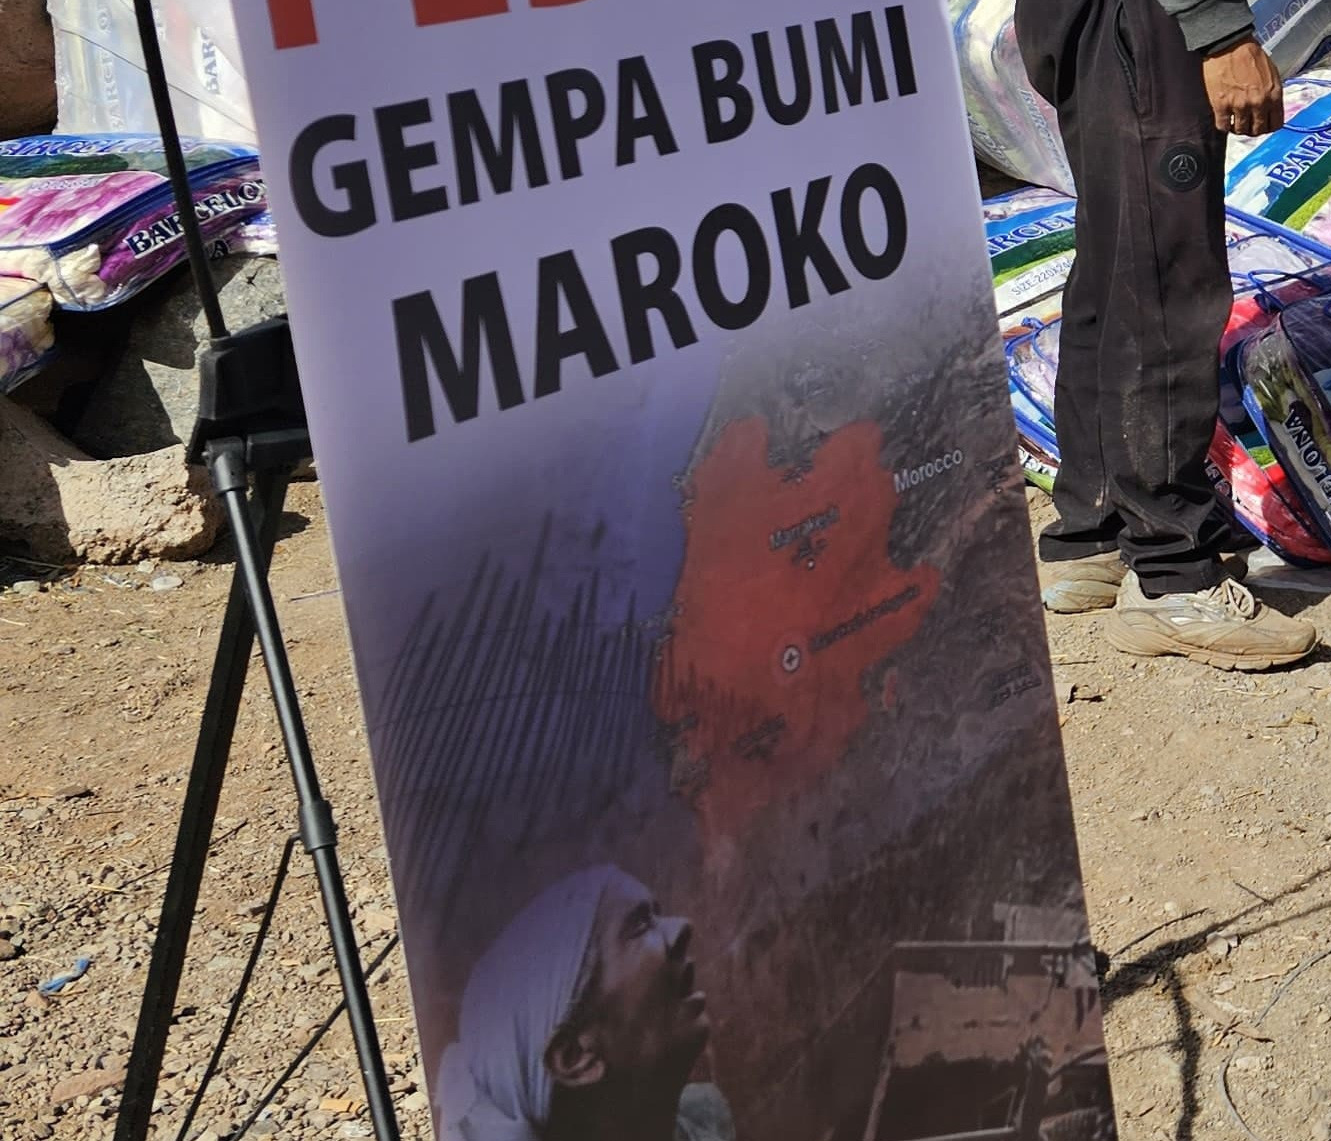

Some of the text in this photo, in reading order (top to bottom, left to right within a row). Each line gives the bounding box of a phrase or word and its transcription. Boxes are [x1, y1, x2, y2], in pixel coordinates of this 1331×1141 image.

[288, 54, 680, 239] GEMPA
[691, 4, 919, 145] BUMI
[392, 162, 908, 444] MAROKO
[893, 448, 964, 494] Morocco
